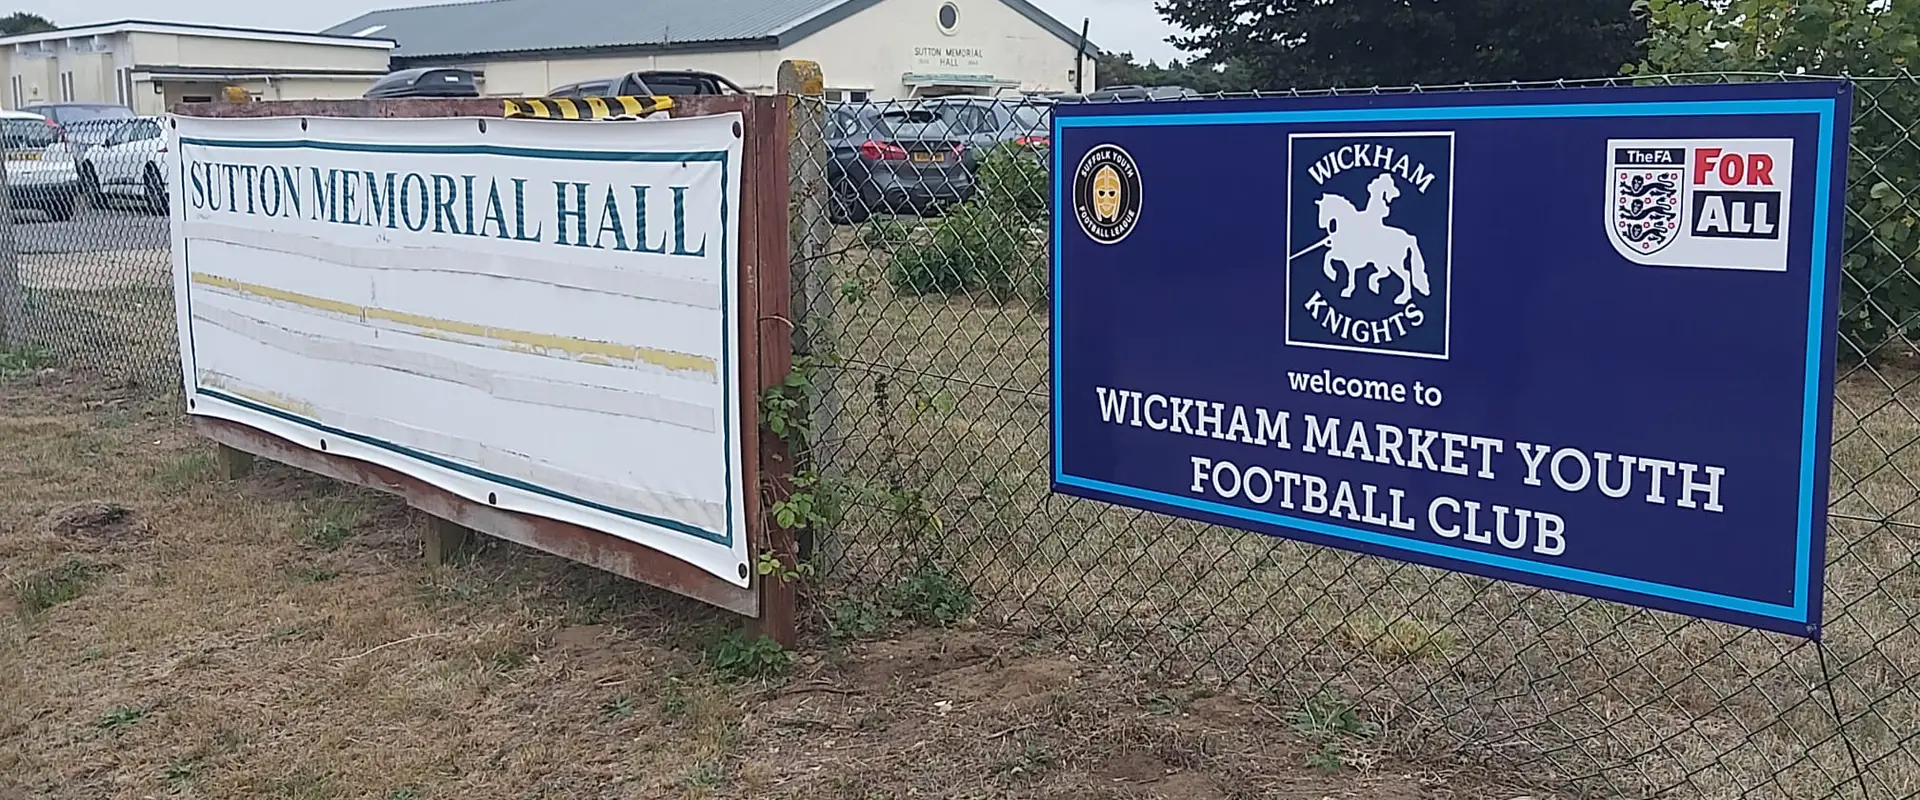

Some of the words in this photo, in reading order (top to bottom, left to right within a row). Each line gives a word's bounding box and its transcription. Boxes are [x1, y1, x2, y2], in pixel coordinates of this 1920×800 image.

[914, 47, 941, 56] SUTTON
[946, 48, 983, 58] MEMORIAL
[940, 58, 958, 67] HALL
[1081, 150, 1111, 178] SUFFOLK
[1112, 151, 1135, 178] YOUTH
[1308, 144, 1435, 194] WICKHAM
[1693, 147, 1774, 187] FOR
[190, 160, 302, 219] SUTTON
[310, 166, 543, 243] MEMORIAL
[552, 180, 708, 258] HALL
[1079, 205, 1109, 238] FOOTBALL
[1110, 209, 1136, 237] LEAGUE
[1696, 195, 1775, 235] ALL
[1304, 290, 1425, 344] KNIGHTS
[1287, 369, 1406, 403] welcome
[1412, 381, 1442, 407] to
[1096, 386, 1291, 450] WICKHAM
[1302, 414, 1504, 480] MARKET
[1516, 441, 1726, 513] YOUTH
[1191, 456, 1416, 531] FOOTBALL
[1428, 496, 1567, 557] CLUB
